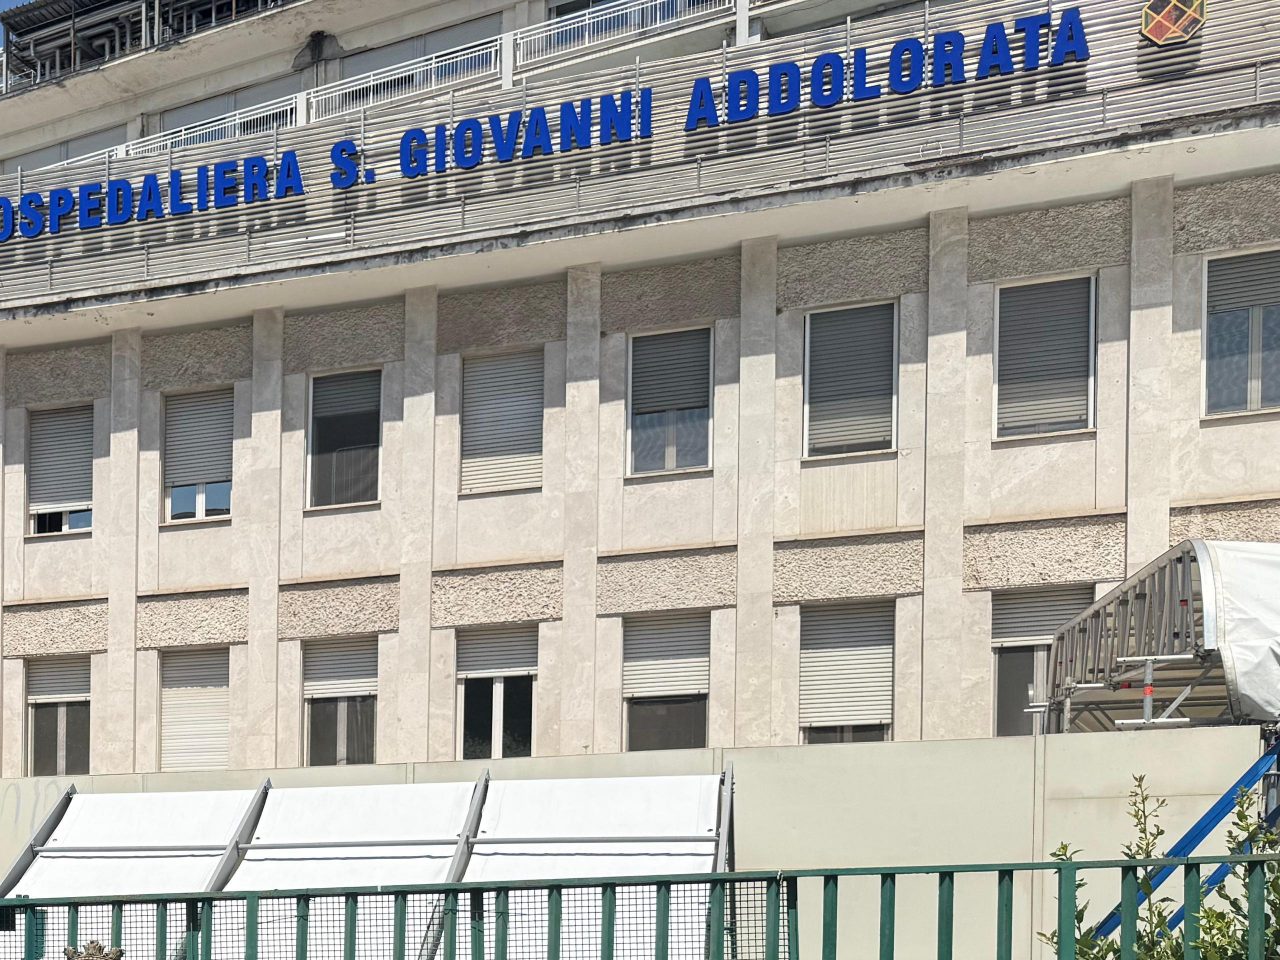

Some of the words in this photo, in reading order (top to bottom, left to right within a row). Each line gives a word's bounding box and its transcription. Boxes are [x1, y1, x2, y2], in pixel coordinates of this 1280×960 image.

[330, 139, 376, 190] S.
[399, 88, 653, 179] GIOVANNI
[684, 7, 1091, 131] ADDOLORATA
